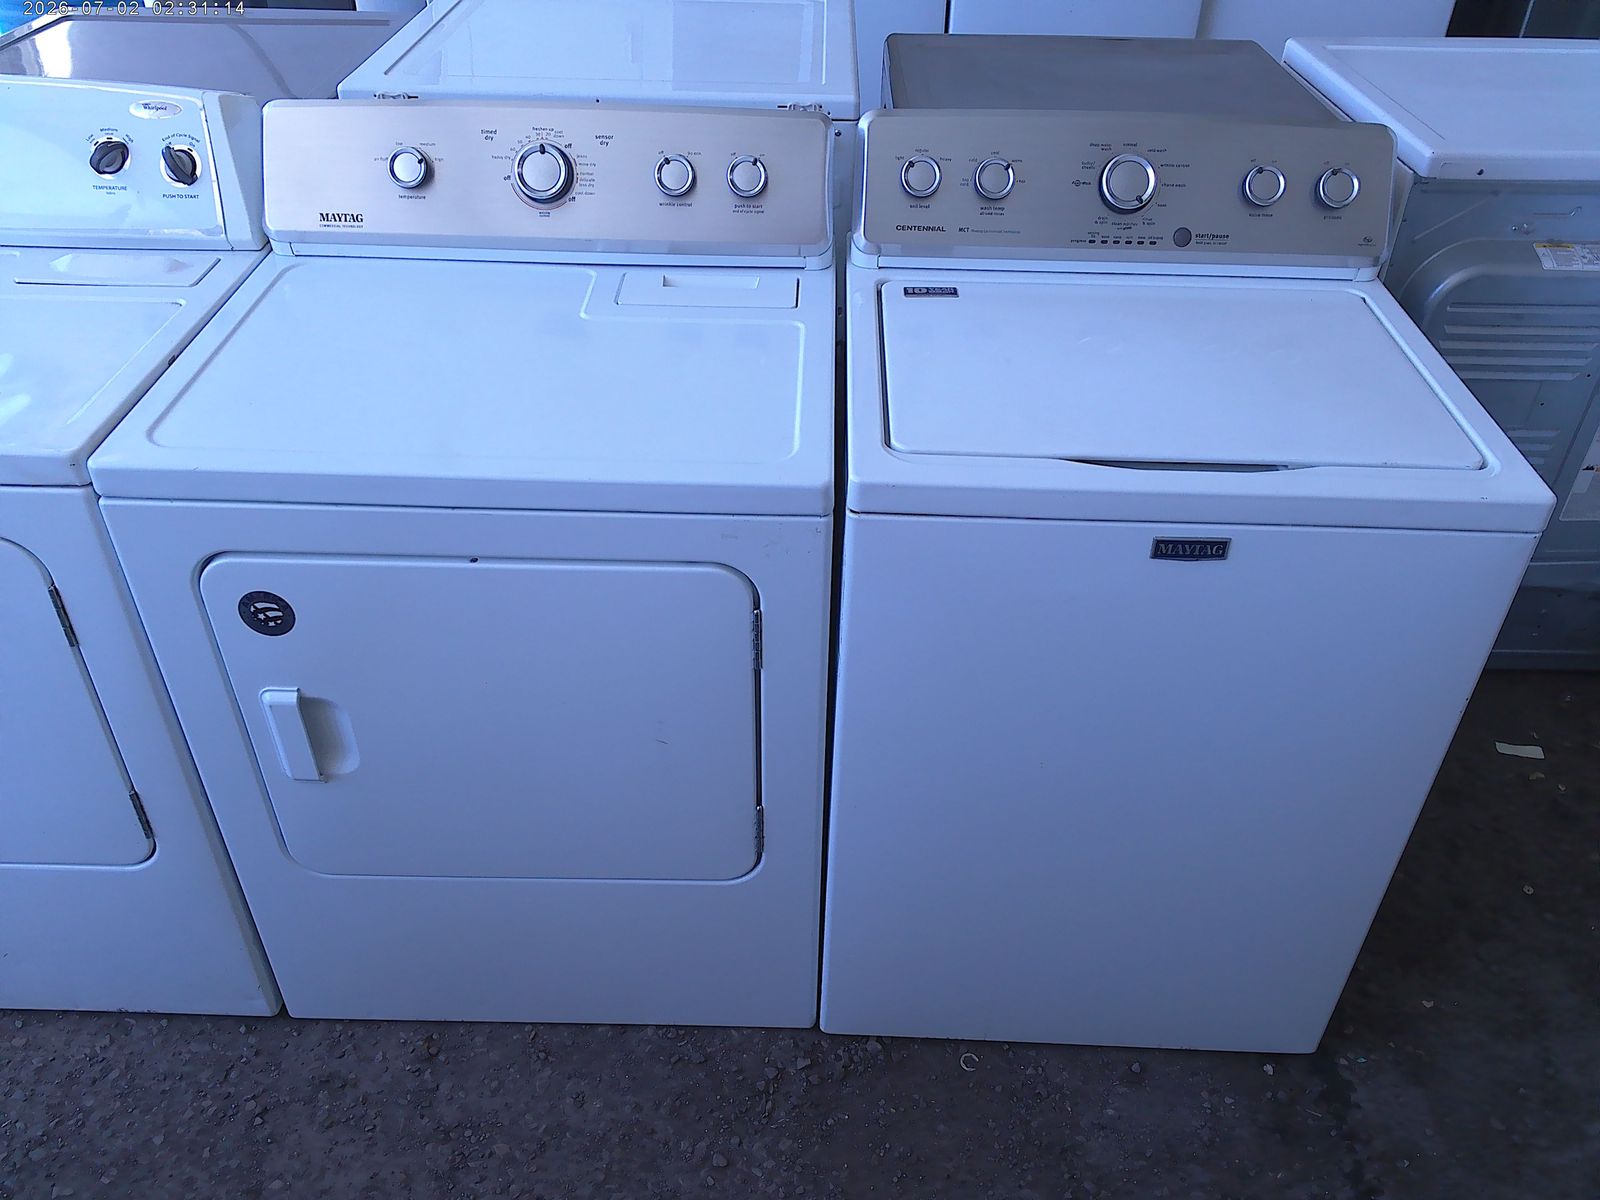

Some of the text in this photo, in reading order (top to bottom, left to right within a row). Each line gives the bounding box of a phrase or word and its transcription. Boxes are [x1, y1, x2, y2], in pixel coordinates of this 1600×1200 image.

[142, 103, 168, 111] Whirlpool
[319, 213, 364, 223] MAYTAG
[906, 287, 928, 295] 10
[1158, 544, 1223, 555] MAYTAG
